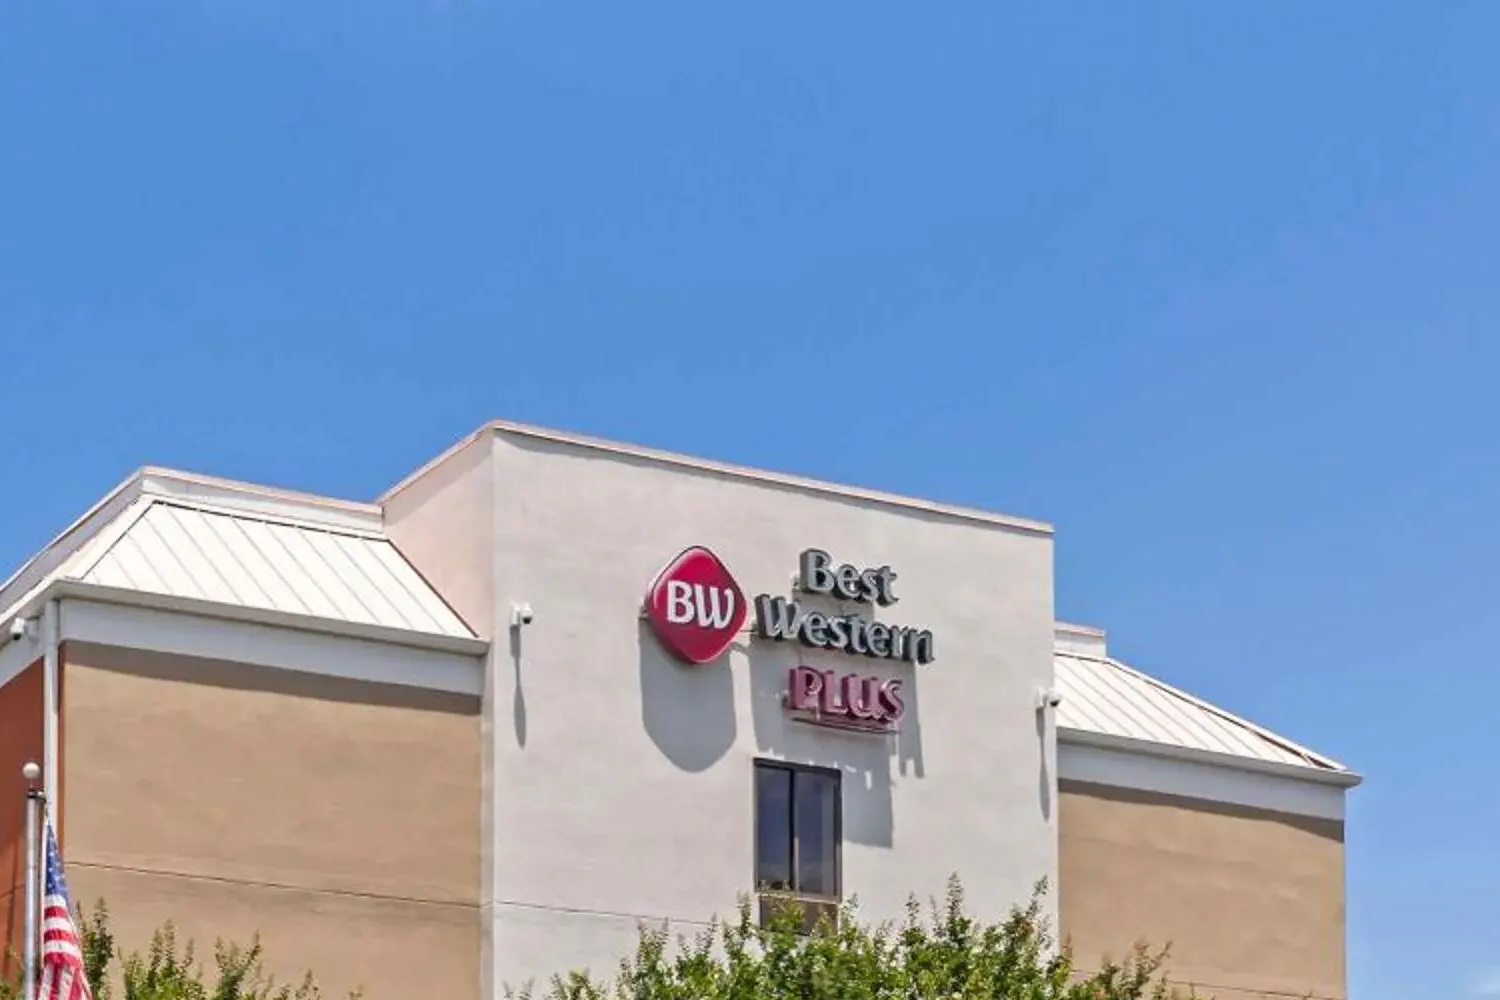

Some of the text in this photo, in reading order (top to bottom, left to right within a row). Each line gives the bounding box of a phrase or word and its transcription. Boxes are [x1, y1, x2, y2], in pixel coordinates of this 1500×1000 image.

[667, 580, 734, 629] BW
[801, 549, 899, 607] Best
[754, 594, 935, 664] Western
[787, 666, 905, 722] PLUS
